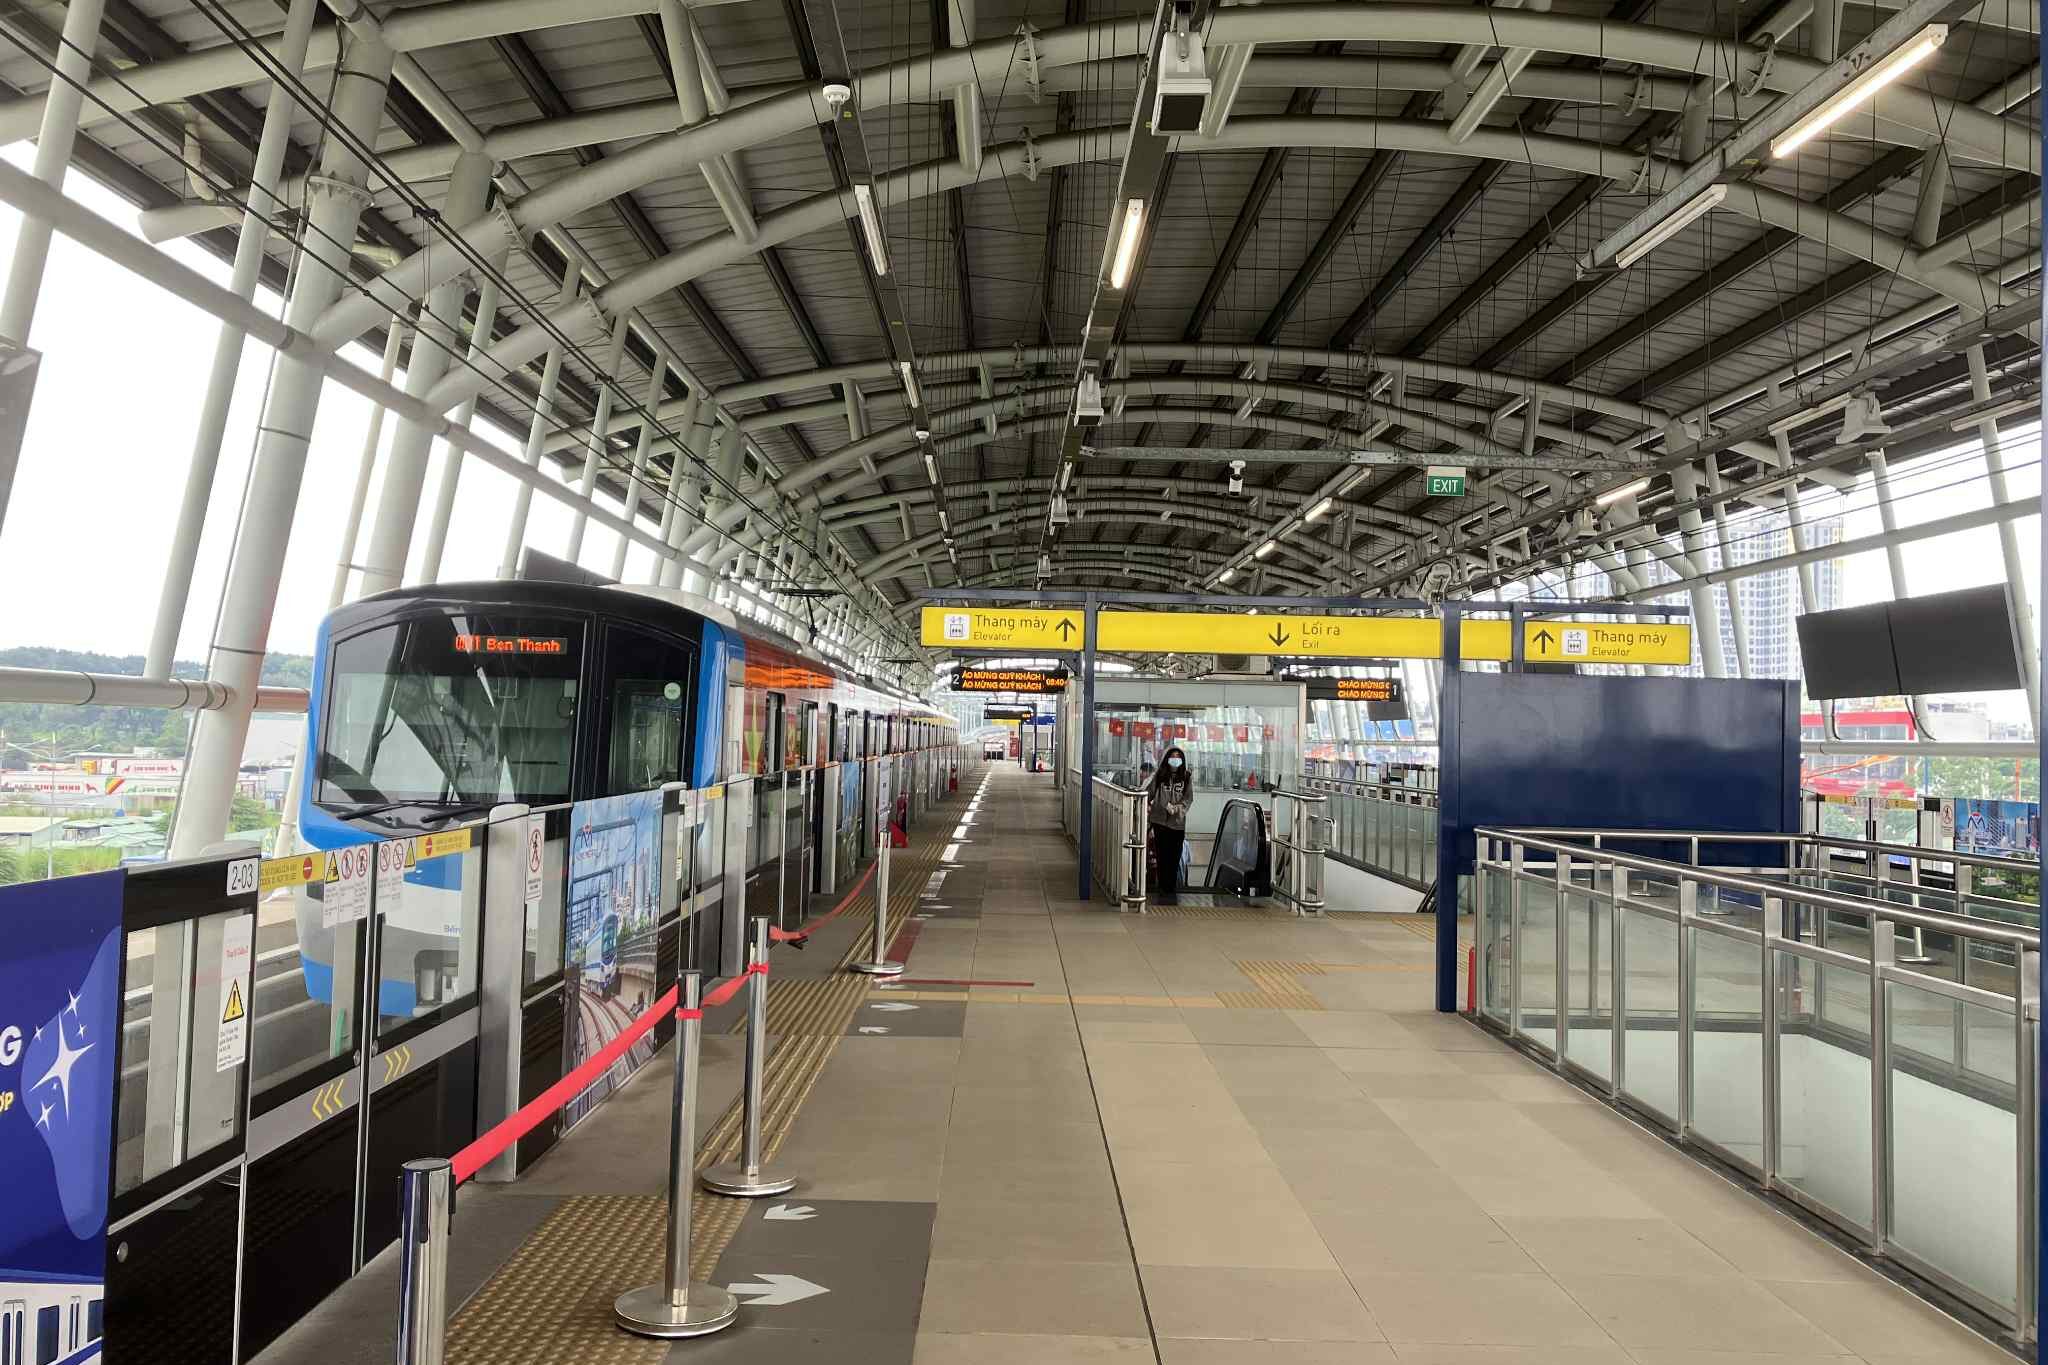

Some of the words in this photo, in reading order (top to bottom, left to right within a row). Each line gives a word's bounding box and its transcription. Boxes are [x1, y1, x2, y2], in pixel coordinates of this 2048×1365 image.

[1433, 479, 1459, 493] EXIT
[975, 614, 1015, 630] Thang
[1020, 617, 1048, 631] máy
[973, 632, 1013, 641] Elevator
[1327, 626, 1341, 636] ra
[1592, 629, 1634, 645] Thang
[1639, 631, 1668, 646] máy
[486, 638, 513, 651] Ben
[518, 639, 561, 652] Thanh
[1302, 640, 1319, 649] Exit
[1592, 647, 1631, 657] Elevator
[953, 674, 960, 685] 2
[1393, 684, 1398, 695] 1
[231, 863, 253, 891] 2-03
